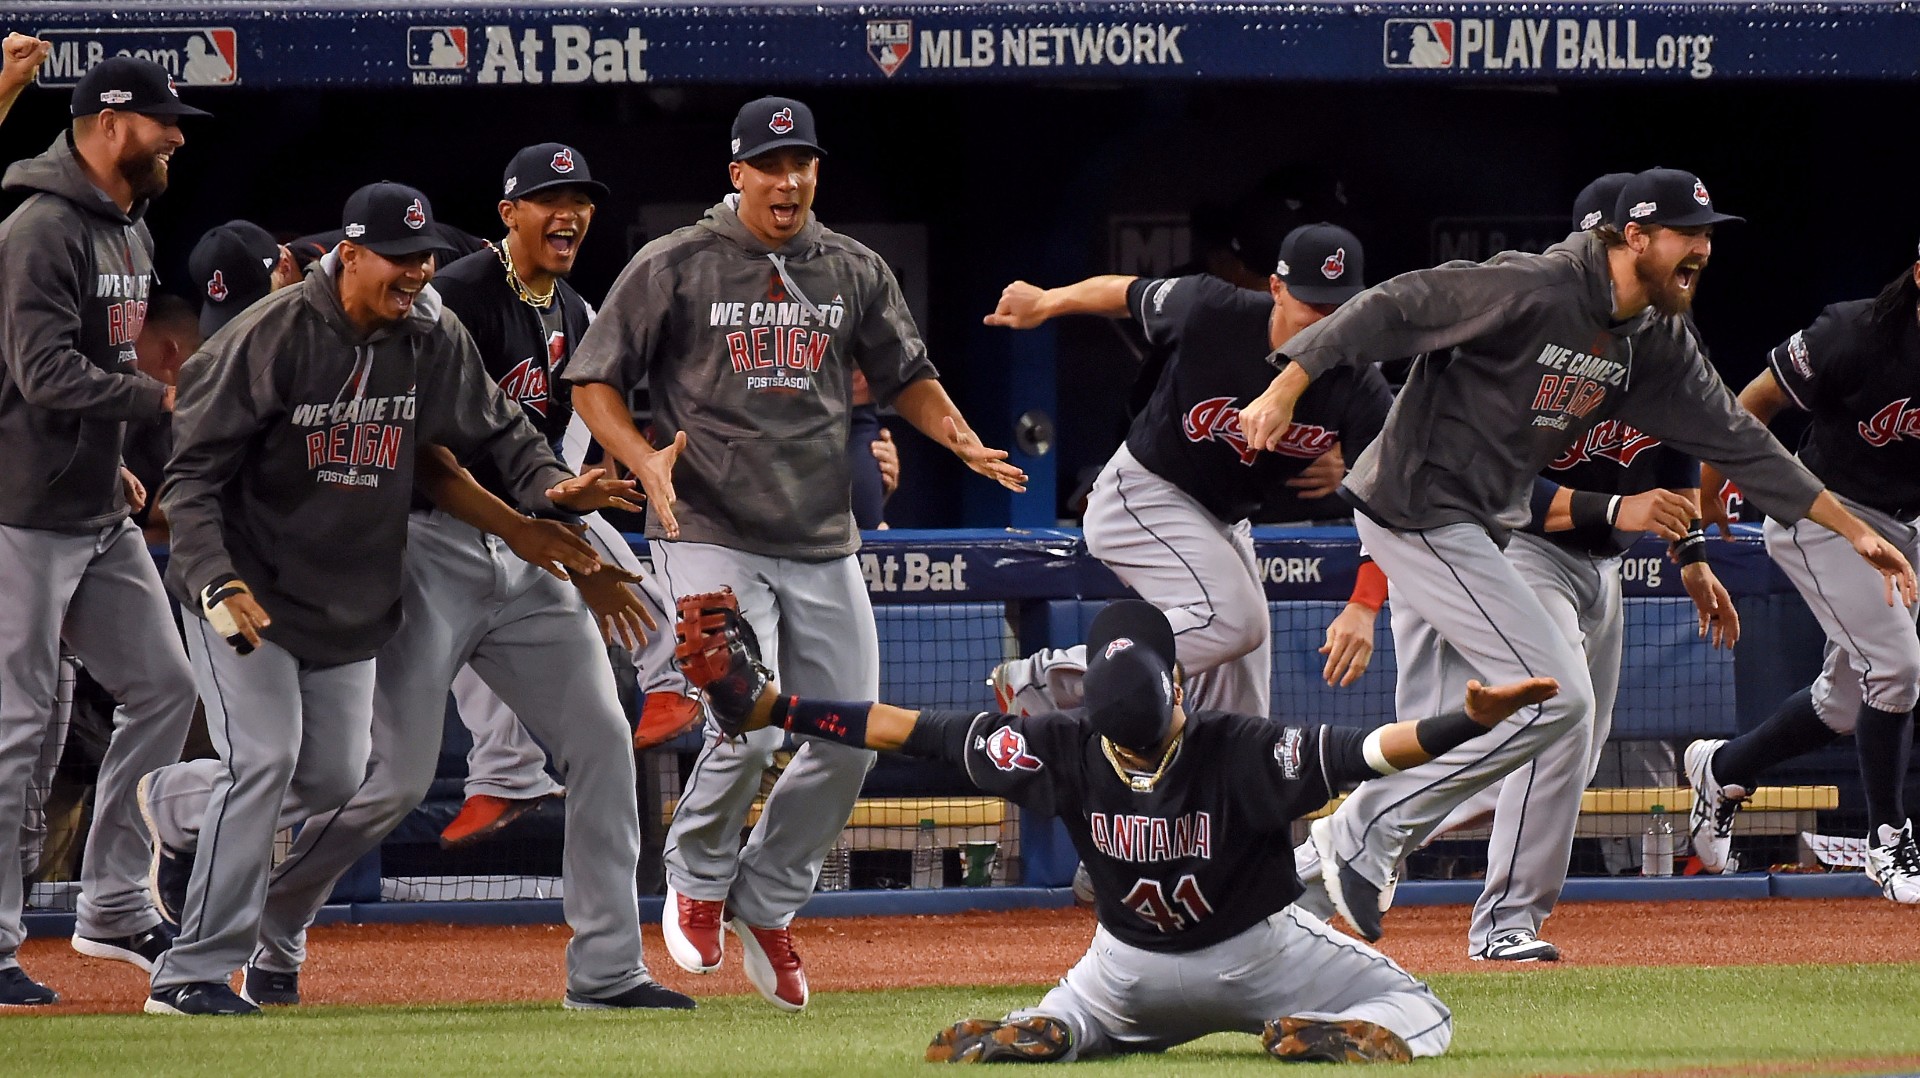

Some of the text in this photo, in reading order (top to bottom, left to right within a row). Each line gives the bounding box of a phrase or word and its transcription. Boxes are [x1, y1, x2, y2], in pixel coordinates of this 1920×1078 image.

[477, 25, 648, 83] At Bat
[920, 25, 1184, 68] MLB NETWORK
[1459, 18, 1713, 79] PLAY BALL.org
[412, 71, 462, 85] MLB.com
[96, 274, 121, 298] WE
[710, 302, 844, 329] WE CAME TO
[726, 326, 829, 374] REIGN
[1536, 343, 1573, 371] WE
[1567, 352, 1613, 383] CAME
[747, 376, 810, 391] POSTSEASON
[291, 395, 416, 427] WE CAME TO
[306, 423, 402, 470] REIGN
[317, 470, 379, 488] POSTSEASON
[860, 552, 968, 592] At Bat
[1121, 873, 1214, 933] 41
